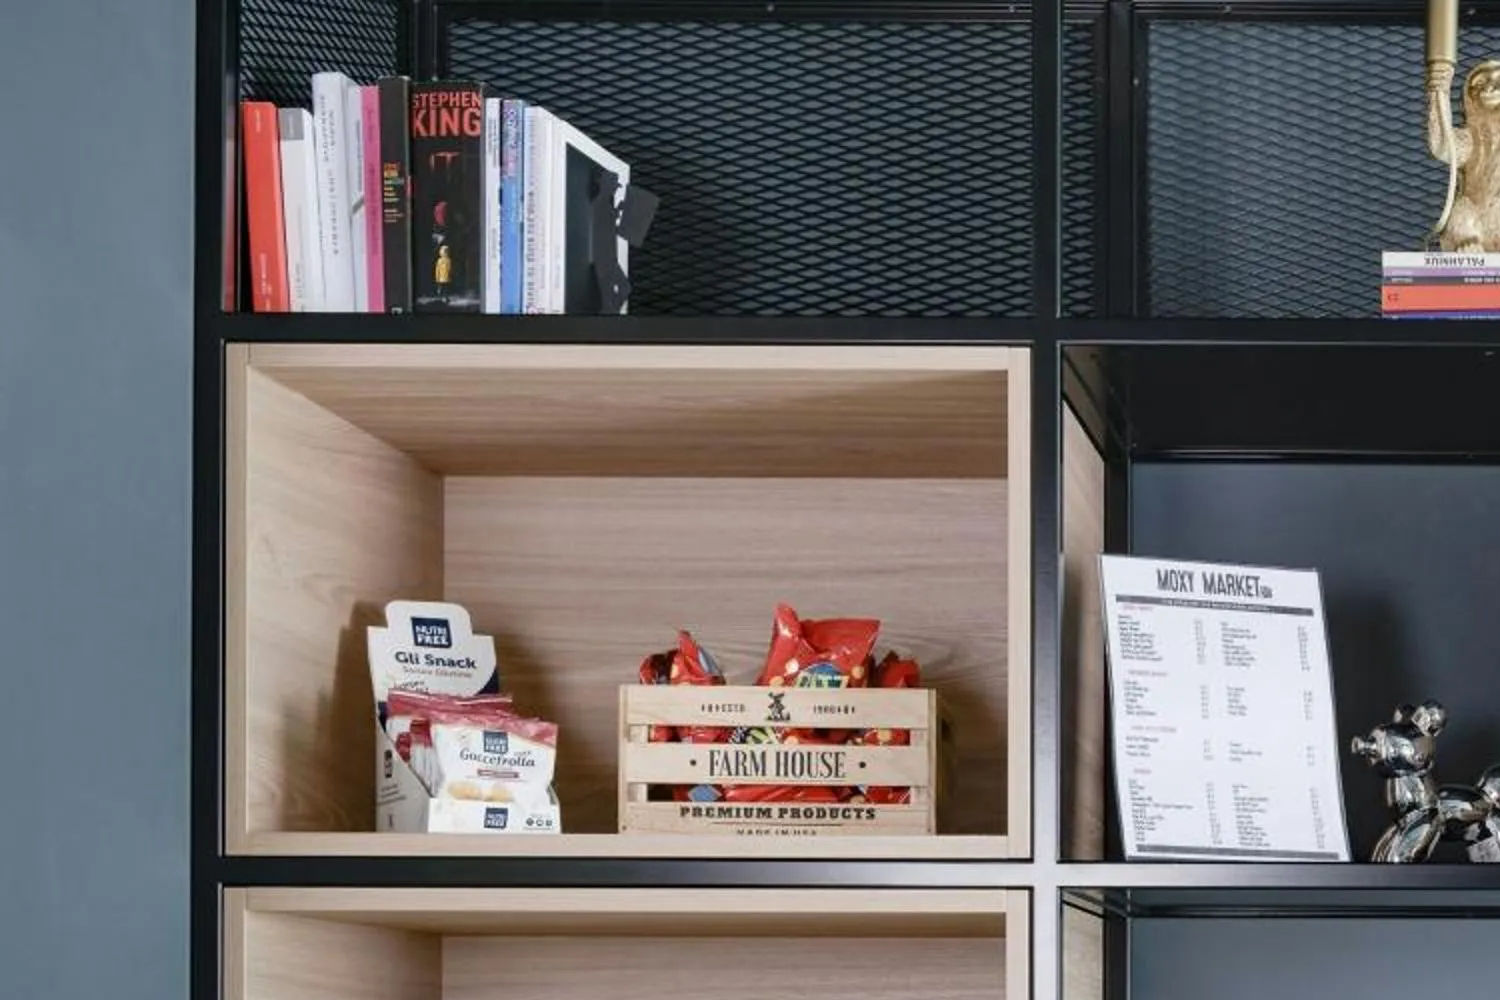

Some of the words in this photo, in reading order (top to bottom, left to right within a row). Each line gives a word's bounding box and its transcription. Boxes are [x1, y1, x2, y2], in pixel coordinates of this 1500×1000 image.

[412, 92, 482, 108] STEPHEN
[412, 108, 482, 137] KING
[430, 151, 460, 170] IT
[1157, 568, 1194, 592] MOXY
[1202, 571, 1261, 597] MARKET
[395, 651, 420, 665] Gli
[424, 653, 477, 669] Snack
[709, 750, 767, 777] FARM
[775, 751, 847, 779] HOUSE
[680, 806, 773, 819] PREMIUM
[778, 807, 877, 820] PRODUCTS
